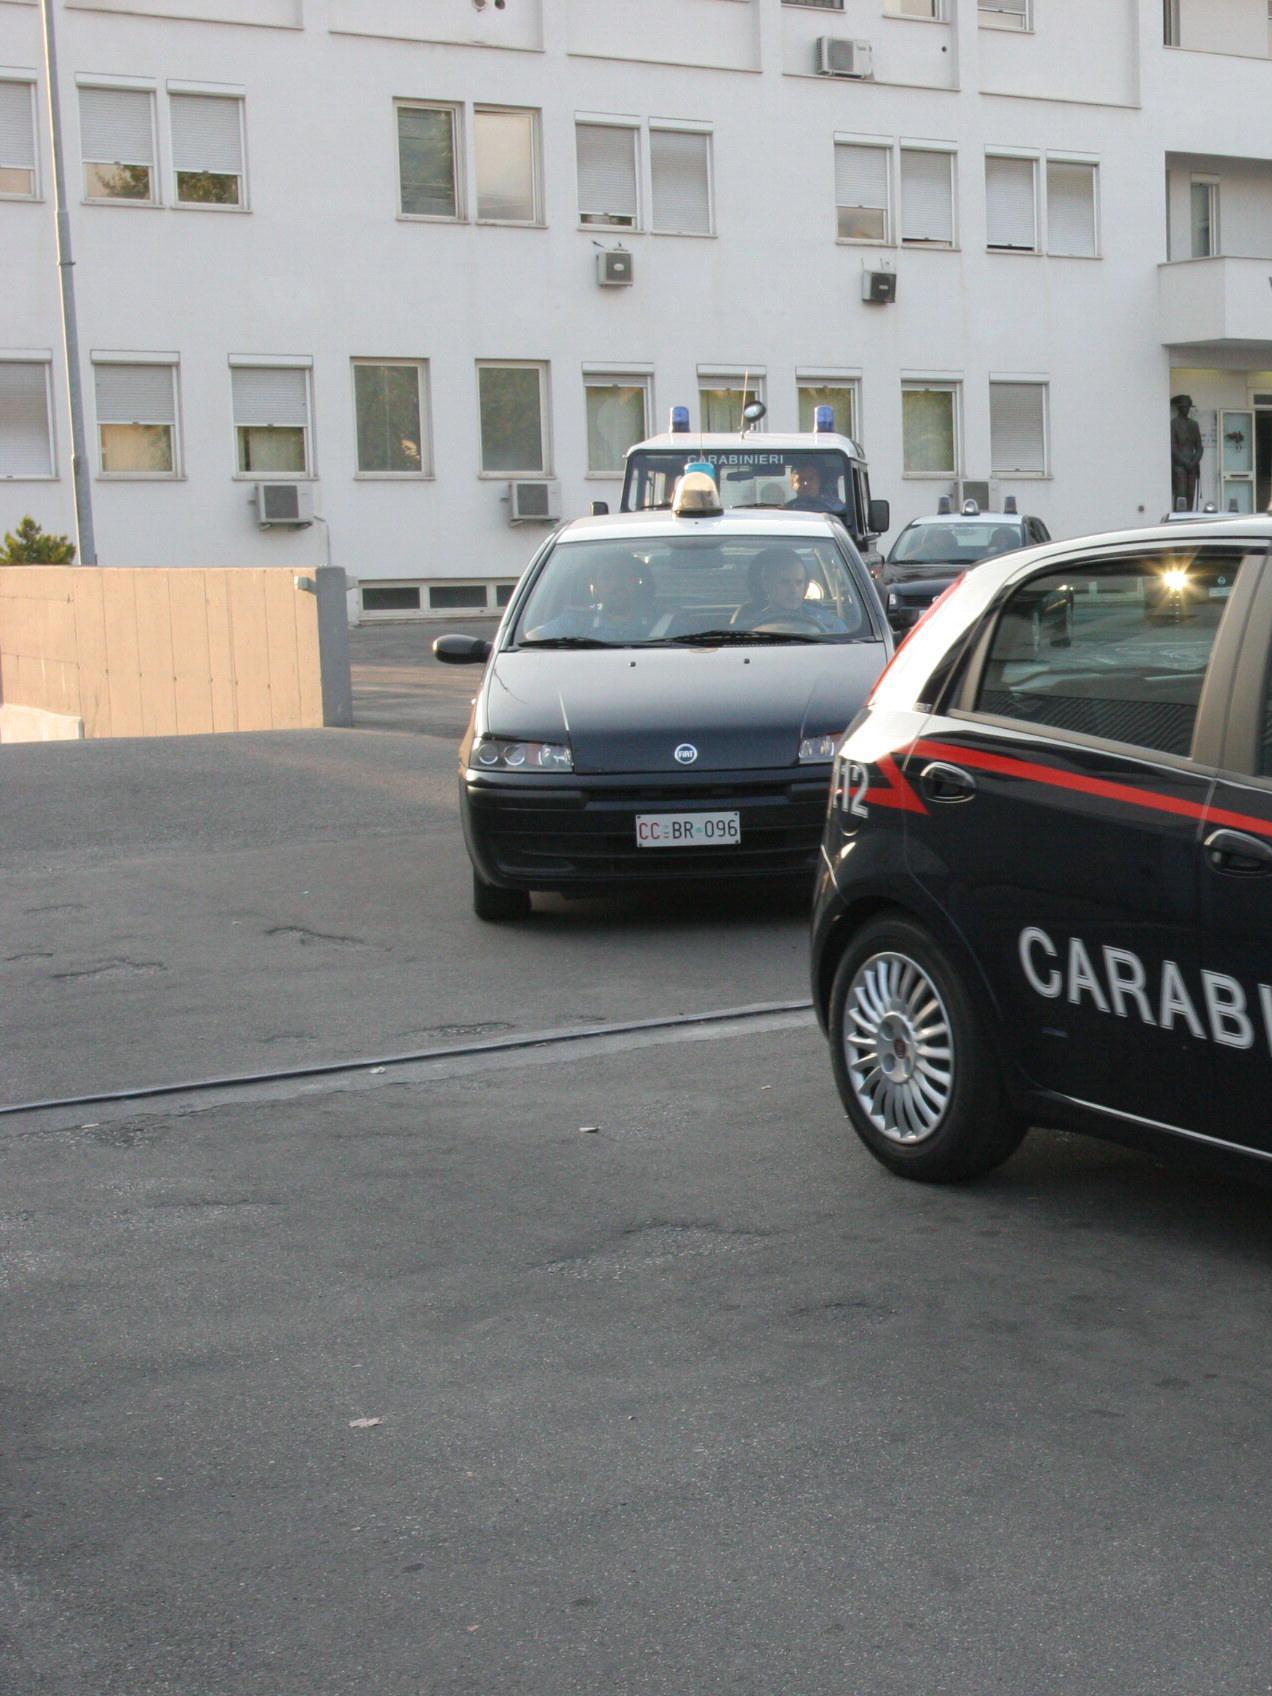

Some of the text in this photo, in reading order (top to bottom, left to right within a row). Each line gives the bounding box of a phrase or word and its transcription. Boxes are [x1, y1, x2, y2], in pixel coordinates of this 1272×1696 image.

[687, 454, 784, 465] CARABINIERI
[639, 819, 738, 840] CC BR 096
